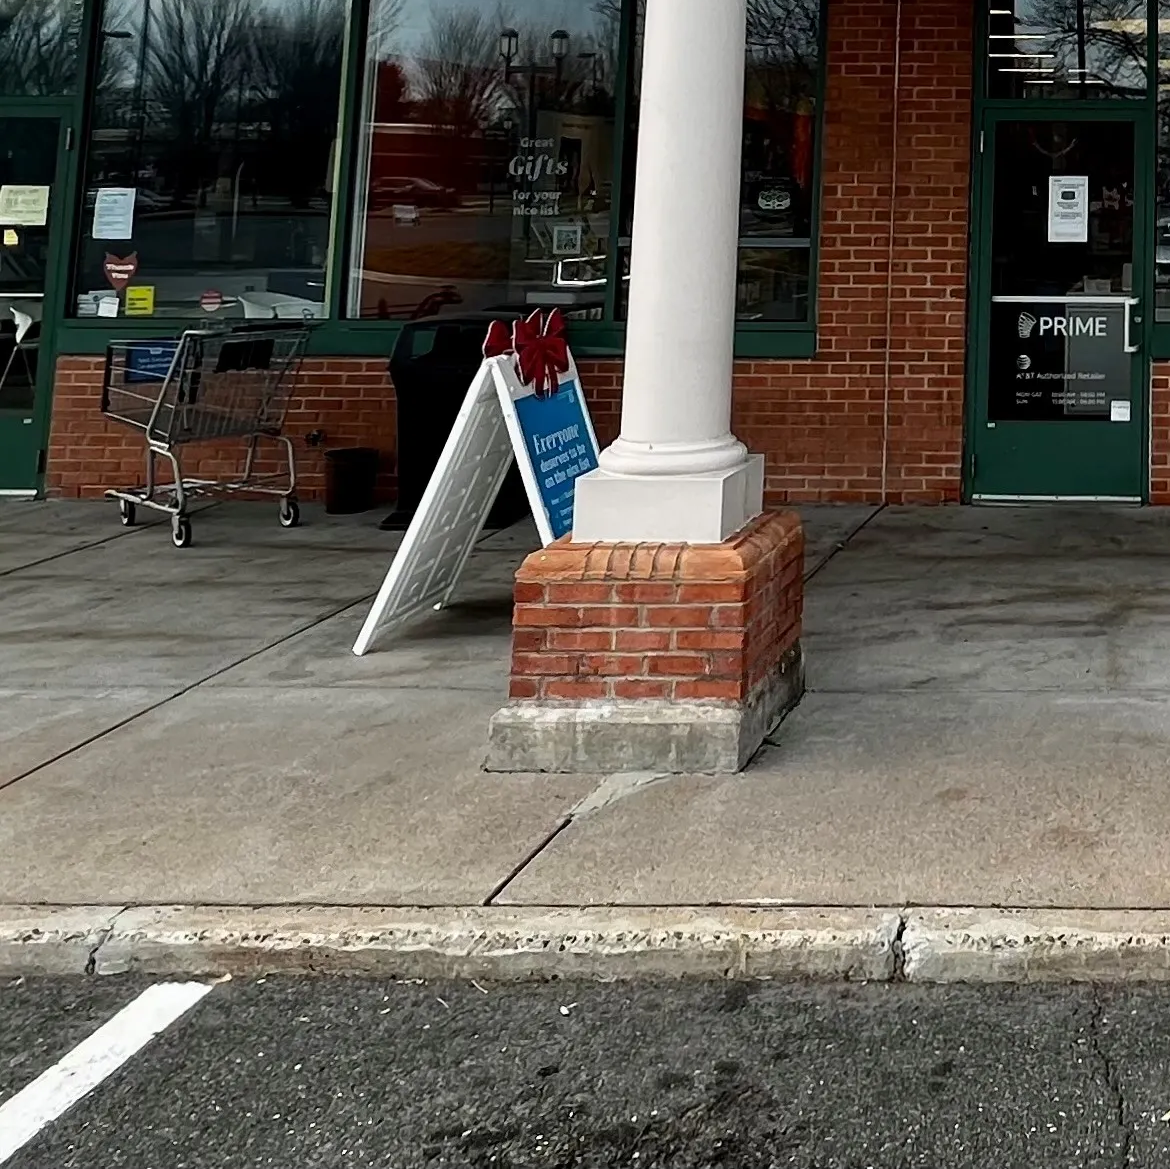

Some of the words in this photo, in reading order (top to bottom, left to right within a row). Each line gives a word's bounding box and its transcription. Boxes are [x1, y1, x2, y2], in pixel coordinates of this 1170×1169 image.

[520, 137, 555, 148] Great
[508, 154, 569, 182] Gifts
[512, 189, 531, 201] for
[533, 191, 562, 204] your
[512, 205, 538, 216] nice
[540, 204, 560, 216] list
[1039, 316, 1108, 337] PRIME
[1036, 372, 1076, 380] Authorized
[1077, 372, 1106, 380] Retailer
[533, 423, 580, 456] Everyone
[568, 447, 578, 459] to
